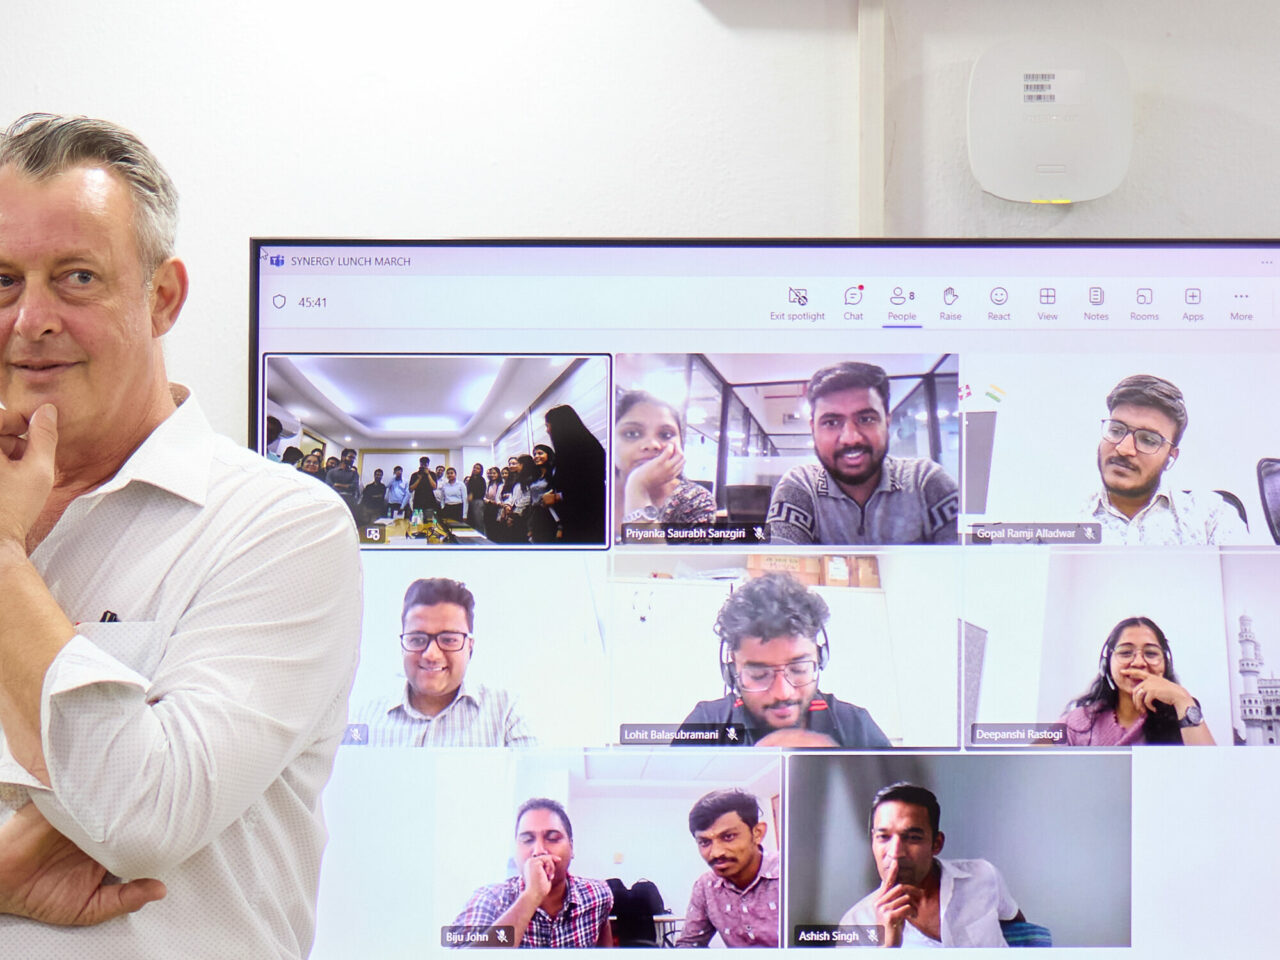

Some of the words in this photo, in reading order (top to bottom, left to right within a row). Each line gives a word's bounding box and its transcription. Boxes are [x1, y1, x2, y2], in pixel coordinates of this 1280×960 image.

[290, 256, 335, 267] SYNERGY
[337, 256, 372, 267] LUNCH
[374, 256, 411, 267] MARCH
[298, 296, 327, 308] 45:41
[770, 312, 786, 321] Exit
[787, 311, 826, 323] spotlight
[843, 311, 864, 321] Chat
[888, 311, 917, 323] People
[939, 311, 963, 321] Raise
[987, 311, 1011, 321] React
[1037, 311, 1059, 321] View
[1083, 311, 1110, 321] Notes
[1130, 311, 1160, 321] Rooms
[1182, 311, 1205, 323] Apps
[1230, 311, 1254, 321] More
[625, 528, 666, 541] Priyanka
[667, 528, 706, 539] Saurabh
[708, 528, 746, 541] Sanzgiri
[976, 528, 1005, 540] Gopal
[1007, 528, 1034, 540] Ramji
[1035, 528, 1076, 539] Alladwar
[624, 729, 649, 740] Lohit
[650, 729, 719, 740] Balasubramani
[976, 729, 1026, 740] Deepanshi
[1027, 729, 1063, 741] Rastogi
[446, 931, 464, 944] Biju
[465, 931, 489, 942] John
[798, 931, 831, 942] Ashish
[831, 931, 859, 943] Singh
